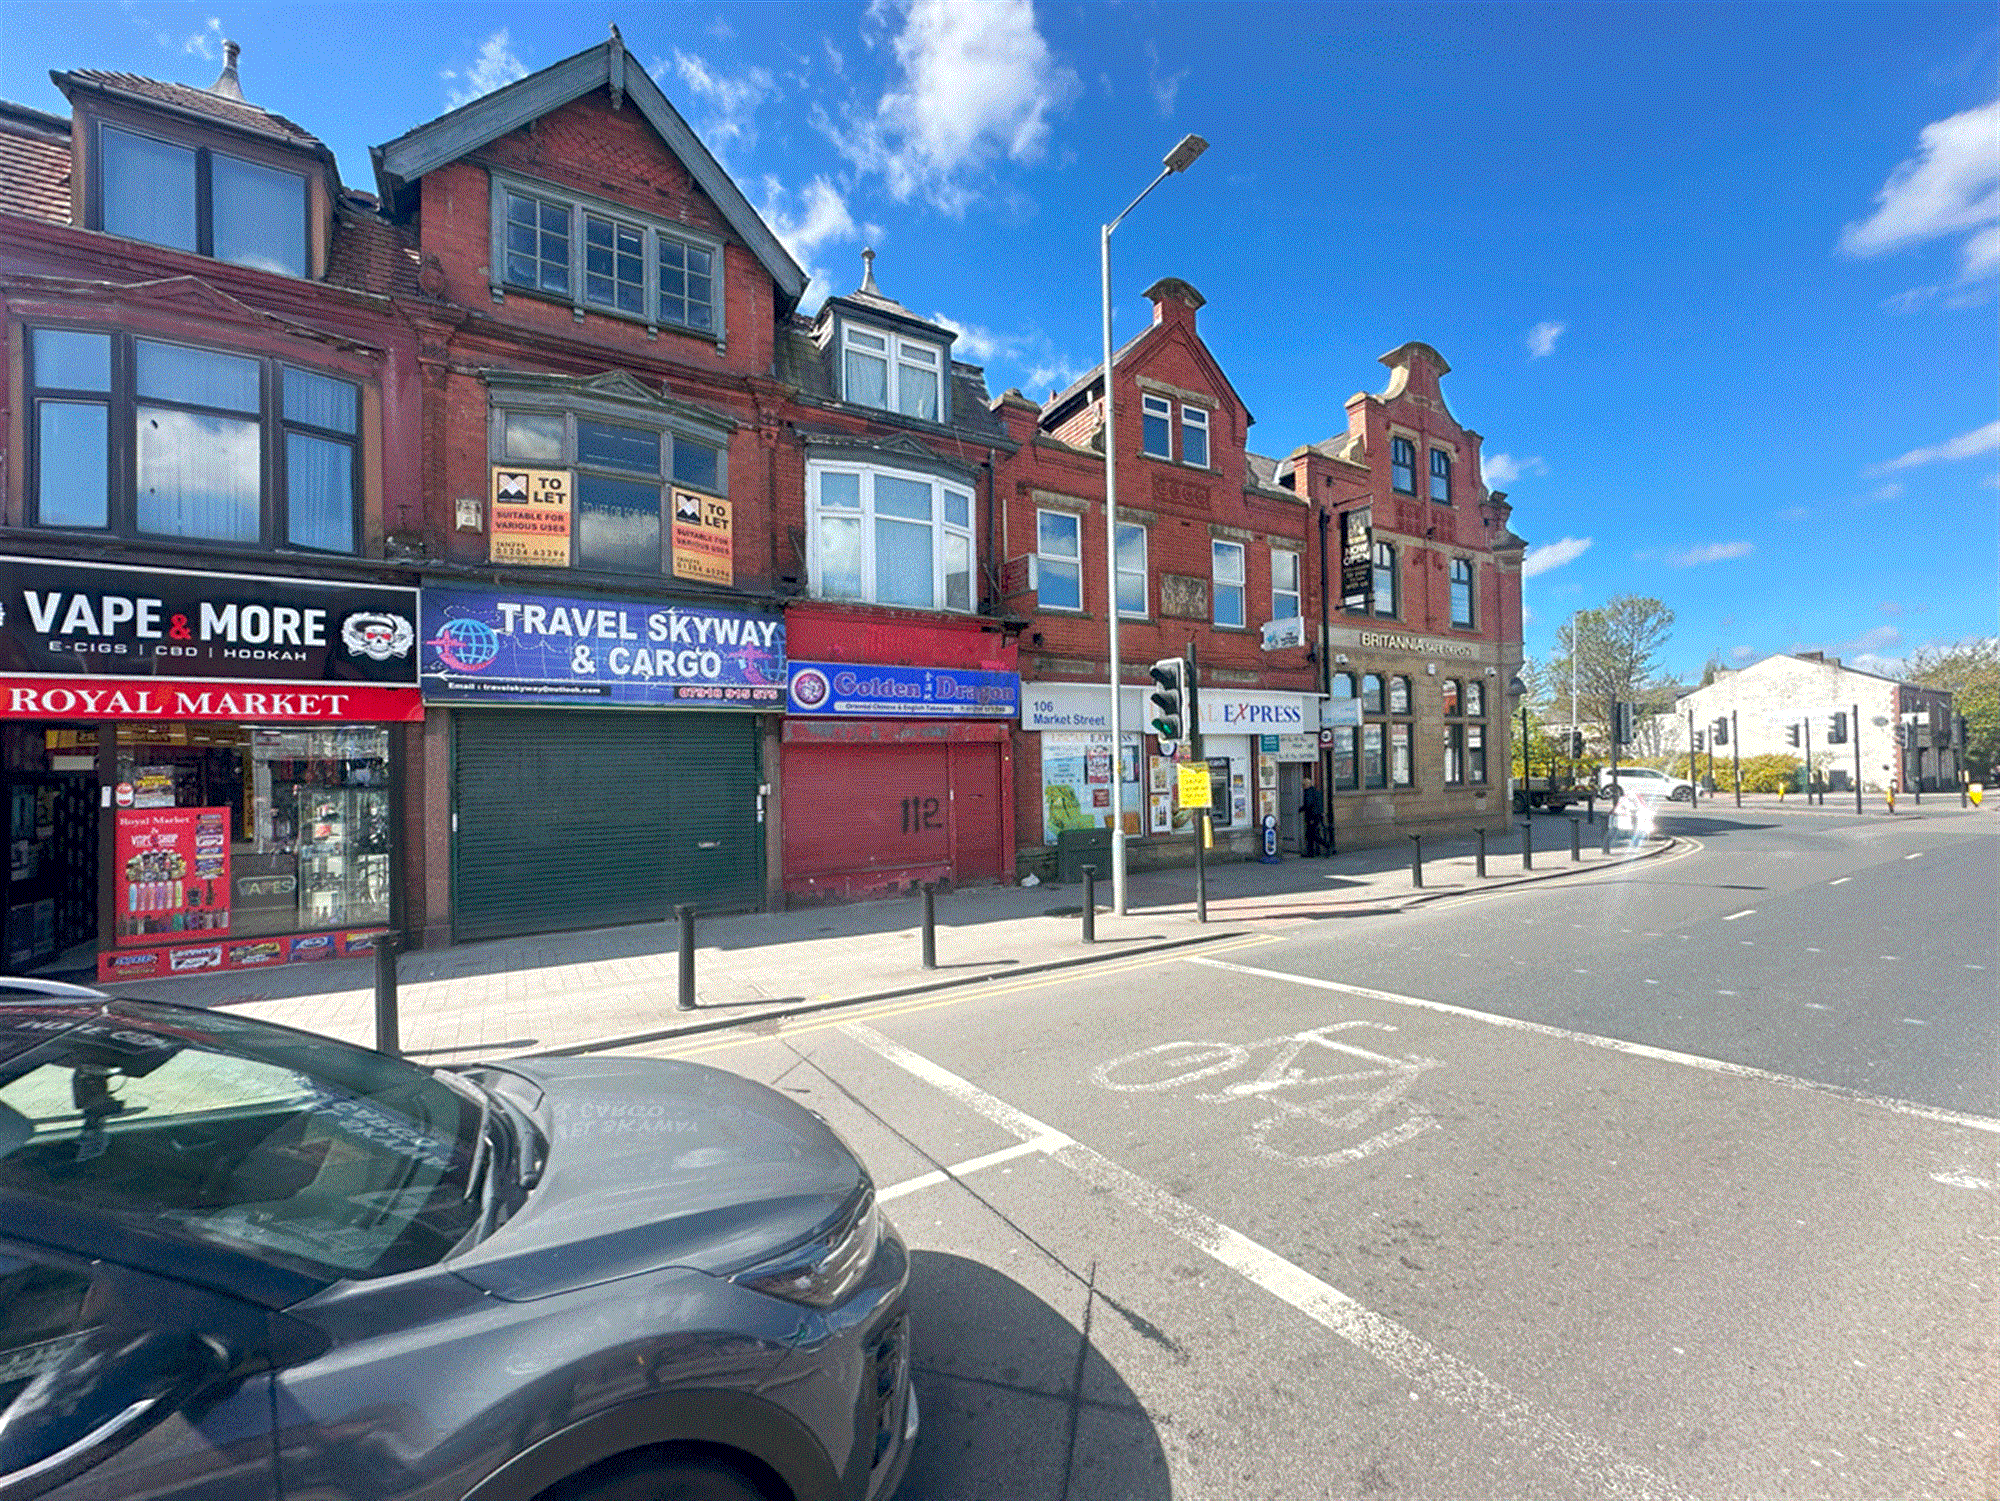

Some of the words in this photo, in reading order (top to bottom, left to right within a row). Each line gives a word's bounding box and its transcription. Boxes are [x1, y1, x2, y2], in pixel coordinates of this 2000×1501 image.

[538, 477, 562, 490] TO
[533, 491, 566, 504] LET
[496, 510, 545, 522] SUITABLE
[547, 513, 564, 523] FOR
[707, 502, 726, 516] TO
[495, 521, 538, 532] VARIOUS
[540, 523, 566, 533] USES
[704, 514, 730, 530] LET
[676, 527, 713, 543] SUITABLE
[715, 535, 730, 545] FOR
[676, 537, 709, 551] VARIOUS
[710, 544, 730, 555] USES
[1343, 551, 1370, 566] OPEN
[23, 590, 162, 639] VAPE
[169, 614, 191, 640] &
[200, 602, 327, 647] MORE
[497, 602, 637, 641] TRAVEL
[648, 613, 777, 648] SKYWAY
[1362, 632, 1424, 652] BRITANNIA
[49, 641, 128, 655] E-CIGS
[155, 645, 199, 658] CBD
[224, 648, 307, 661] HOOKAH
[571, 645, 596, 675] &
[609, 647, 722, 679] CARGO
[448, 682, 475, 691] Email
[833, 671, 921, 698] Golden
[935, 675, 1016, 703] Dragon
[9, 687, 163, 714] ROYAL
[175, 691, 350, 716] MARKET
[1033, 701, 1053, 712] 106
[1033, 713, 1072, 726] Market
[1074, 715, 1106, 727] Street
[1224, 702, 1302, 725] EXPRESS
[120, 817, 150, 828] Royal
[152, 816, 190, 825] Market
[903, 796, 943, 834] 112
